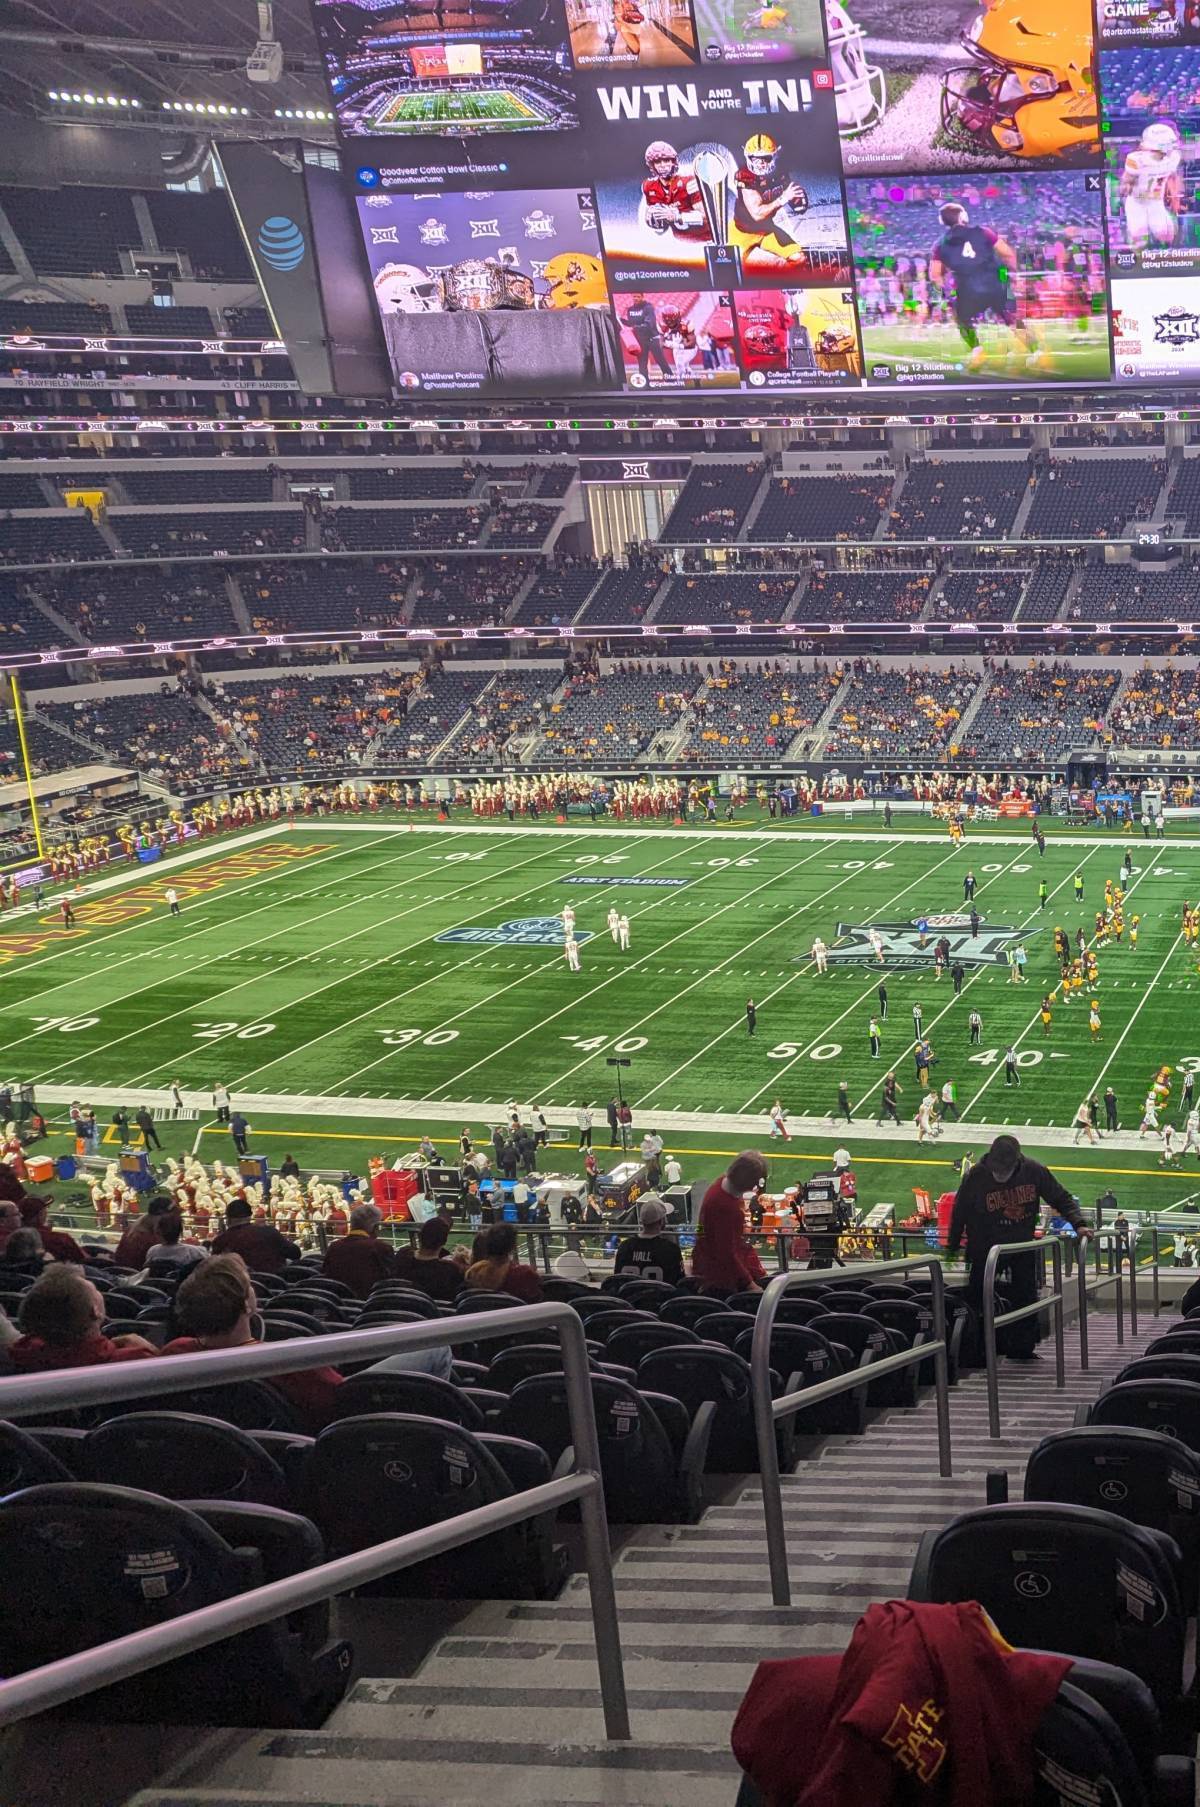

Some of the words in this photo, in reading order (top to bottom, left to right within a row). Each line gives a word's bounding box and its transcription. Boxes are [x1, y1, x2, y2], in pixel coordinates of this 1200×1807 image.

[1104, 3, 1149, 17] GAME
[708, 88, 732, 99] AND
[742, 78, 814, 115] IN!
[597, 83, 700, 120] WIN
[701, 98, 742, 111] YOU'RE
[420, 164, 447, 175] Cotton
[469, 162, 499, 174] Classic
[469, 219, 501, 239] XII
[1157, 249, 1168, 259] 12
[614, 270, 690, 281] @big12conference
[1156, 317, 1198, 338] XII
[767, 371, 790, 379] College
[791, 370, 817, 378] Football
[895, 364, 910, 374] Big
[911, 363, 922, 373] 12
[923, 363, 955, 372] Studios
[622, 462, 649, 479] XII
[445, 852, 489, 861] 10
[571, 855, 631, 864] 20
[706, 857, 759, 868] 30
[841, 860, 895, 870] 40
[981, 864, 1033, 873] 50
[40, 843, 338, 926] STATE
[564, 876, 603, 884] AT&T
[607, 877, 688, 886] STADIUM
[450, 930, 574, 944] Allstate
[33, 1016, 101, 1032] 10
[193, 1022, 277, 1039] 20
[382, 1028, 460, 1046] 30
[572, 1035, 650, 1053] 40
[766, 1042, 844, 1060] 50
[968, 1048, 1044, 1068] 40
[632, 1250, 652, 1262] HALL
[338, 1649, 350, 1671] 13
